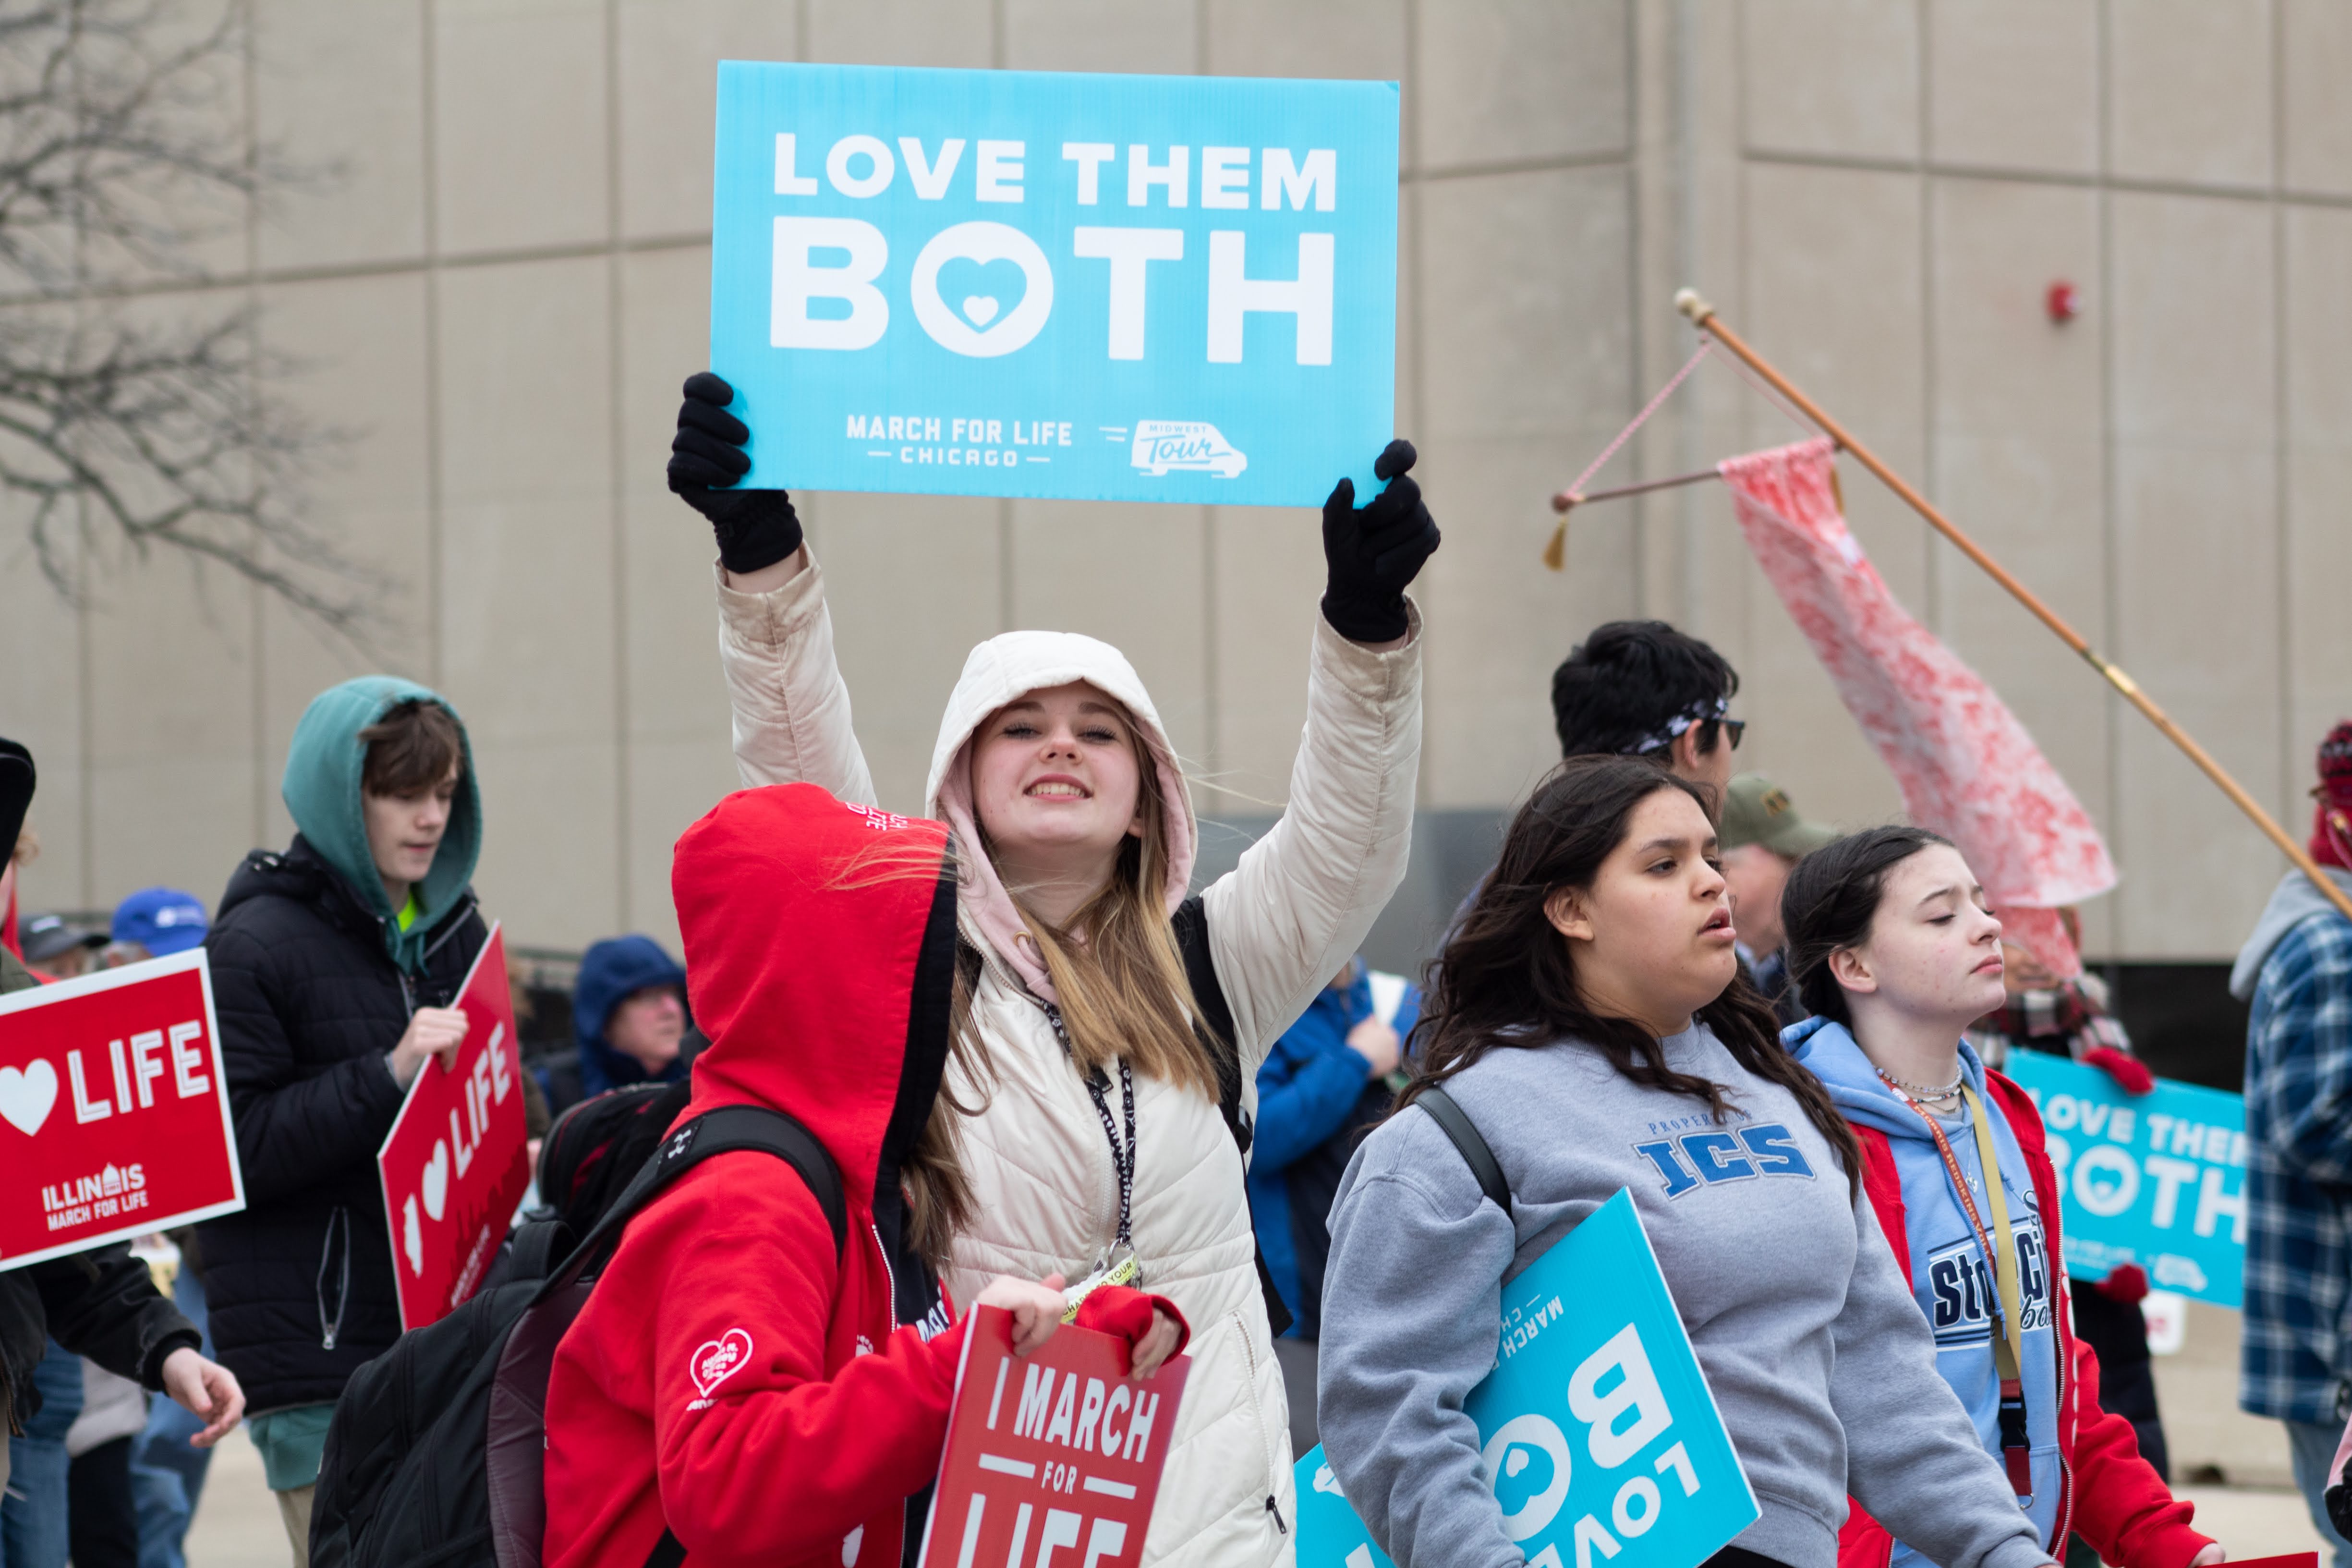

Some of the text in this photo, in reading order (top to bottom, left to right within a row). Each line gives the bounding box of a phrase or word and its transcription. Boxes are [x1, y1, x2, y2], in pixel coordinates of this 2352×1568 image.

[774, 133, 1336, 212] LOVE THEM
[770, 215, 1334, 365] BOTH
[847, 415, 1072, 446] MARCH FOR LIFE
[1140, 434, 1231, 465] Tour
[1149, 424, 1207, 434] MIDWEST
[900, 447, 1018, 467] CHICAGO
[67, 1019, 210, 1125] LIFE
[449, 1021, 512, 1180] LIFE
[1648, 1112, 1728, 1134] PROPER
[1634, 1123, 1817, 1201] ICS
[47, 1190, 149, 1231] MARCH FOR LIFE
[1108, 1262, 1132, 1282] YOUR
[1502, 1295, 1564, 1358] MARCH
[986, 1356, 1160, 1462] I MARCH
[1479, 1322, 1673, 1542] BO
[1041, 1460, 1078, 1495] FOR
